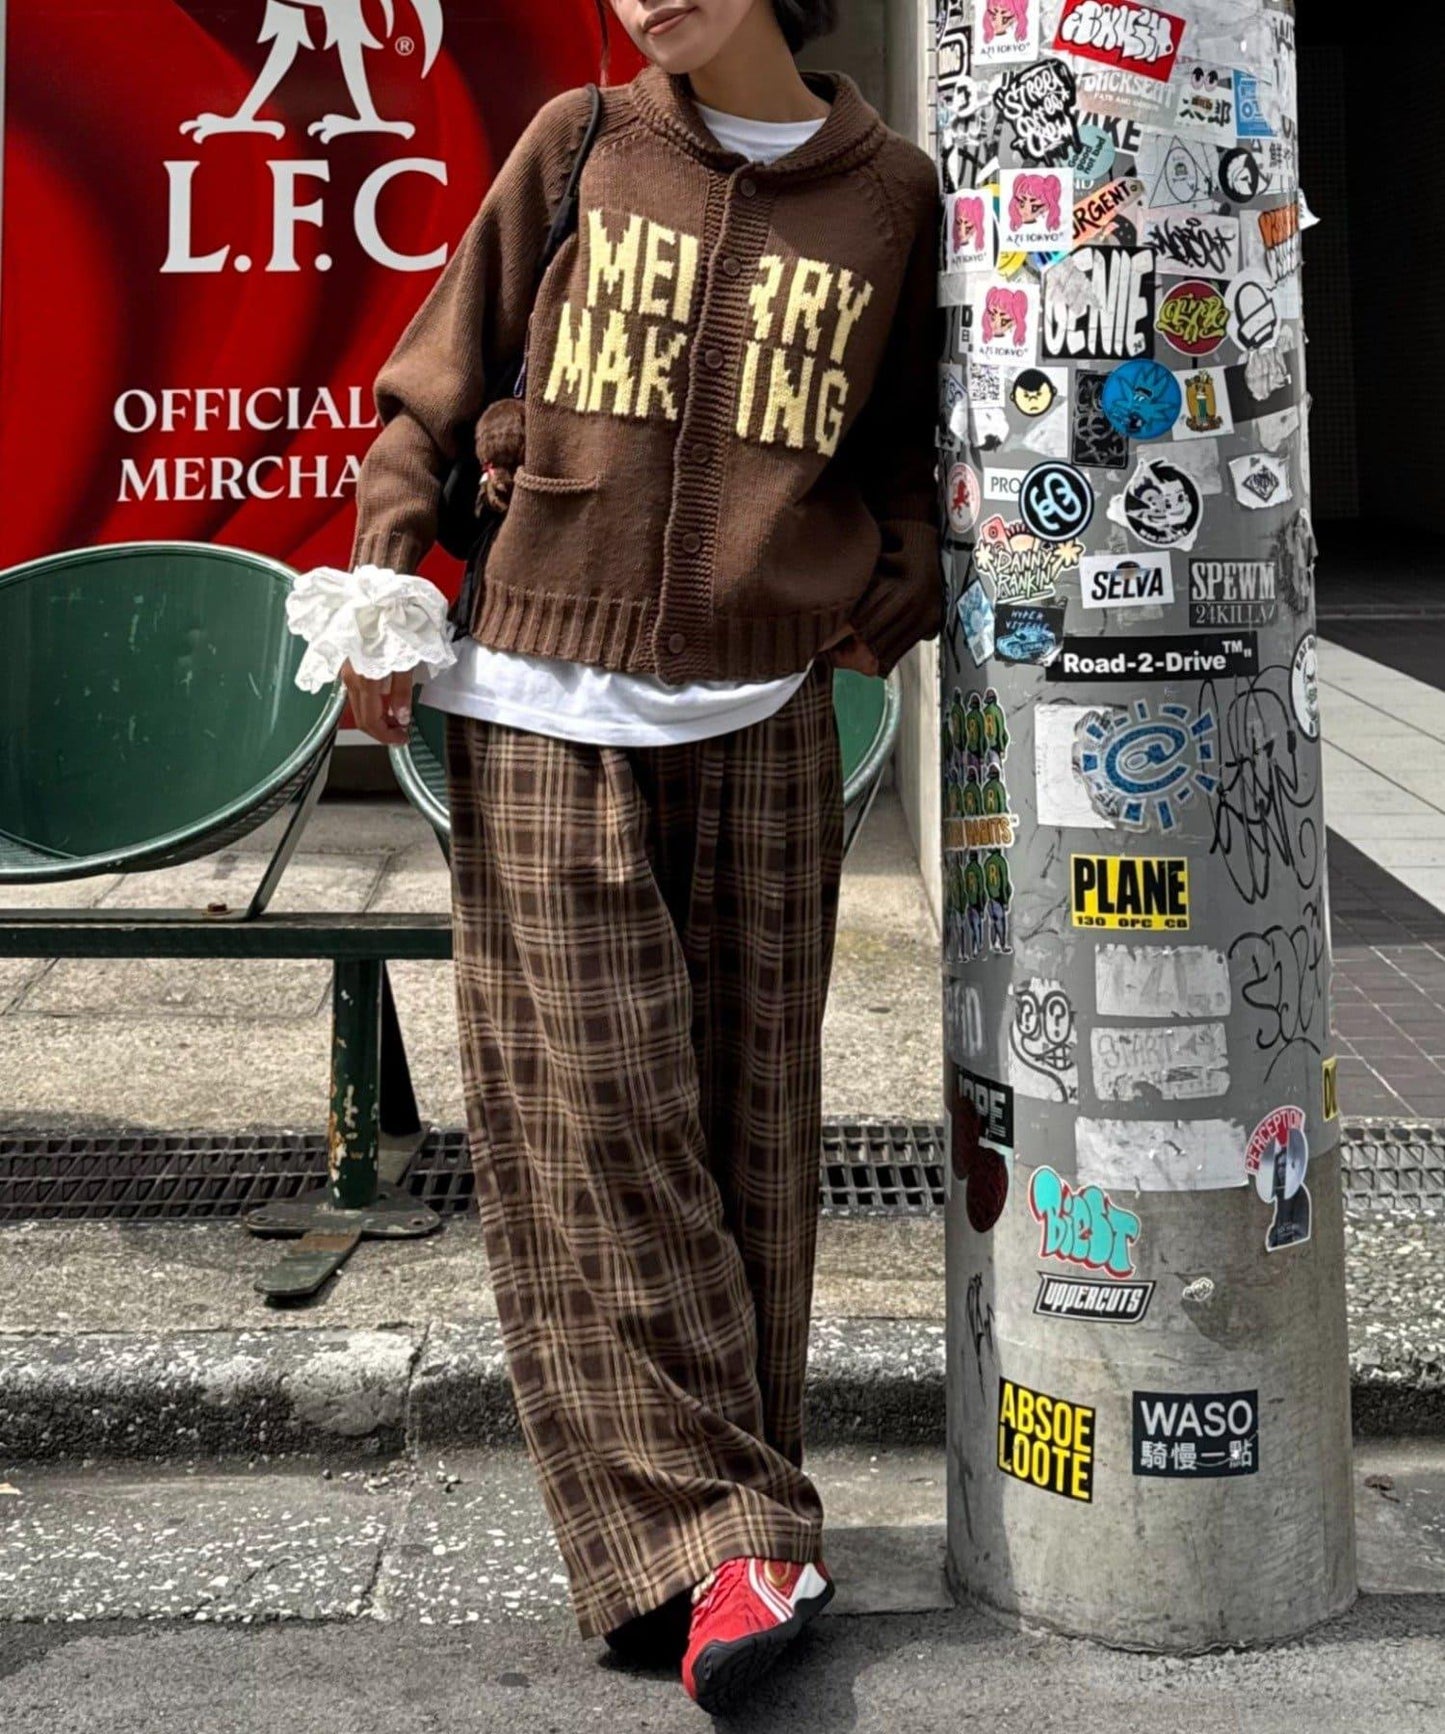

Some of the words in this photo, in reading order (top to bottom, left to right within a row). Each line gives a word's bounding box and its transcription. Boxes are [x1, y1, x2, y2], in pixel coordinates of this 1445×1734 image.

[113, 386, 379, 432] OFFICIAL
[997, 551, 1052, 574] DANNY
[1091, 566, 1164, 600] SELVA
[998, 572, 1053, 599] RANKIN
[1074, 858, 1186, 914] PLANE
[1077, 916, 1106, 926] 130
[1246, 1109, 1303, 1171] PERCEPTION
[1001, 1382, 1093, 1453] ABSOE
[1140, 1399, 1253, 1438] WASO
[999, 1426, 1090, 1499] LOOTE
